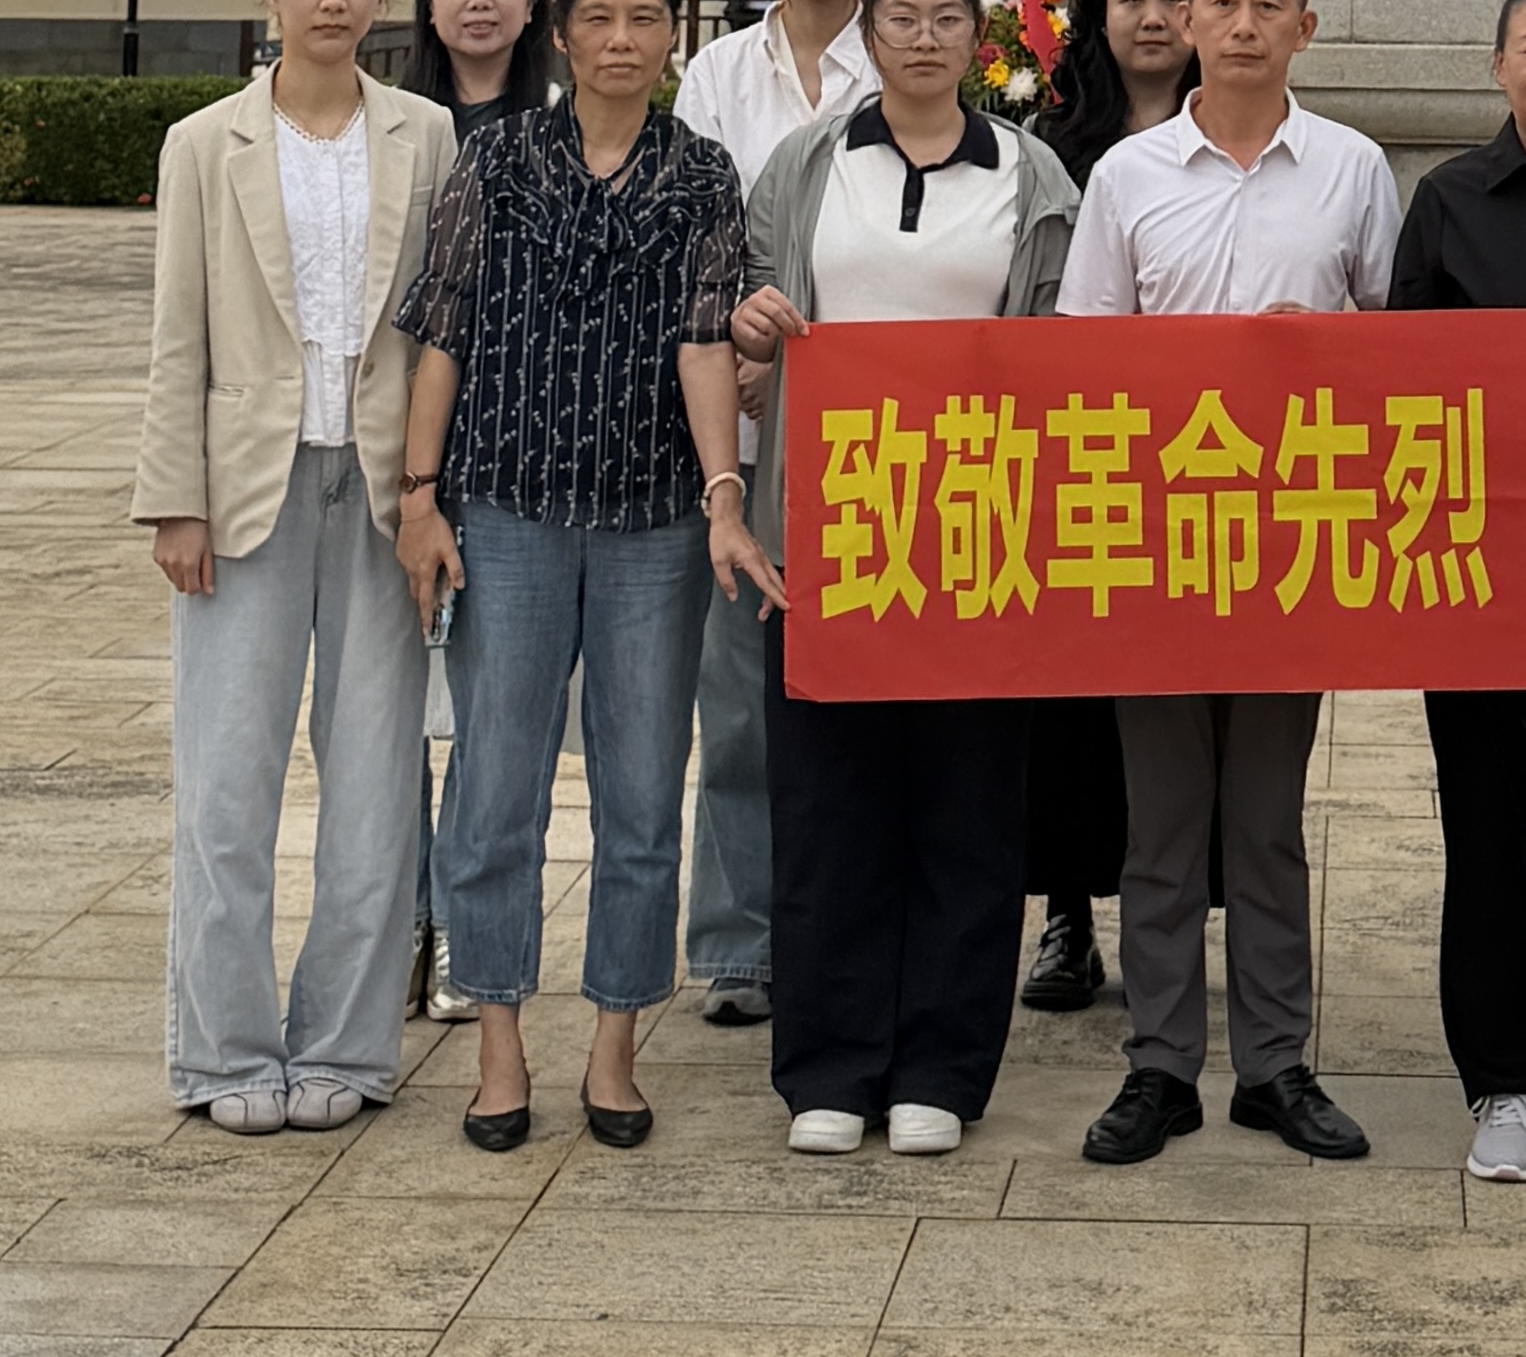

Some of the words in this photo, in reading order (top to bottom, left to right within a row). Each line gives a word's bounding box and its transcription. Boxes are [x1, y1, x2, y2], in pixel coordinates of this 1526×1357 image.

[820, 386, 1494, 623] 致敬革命先烈
